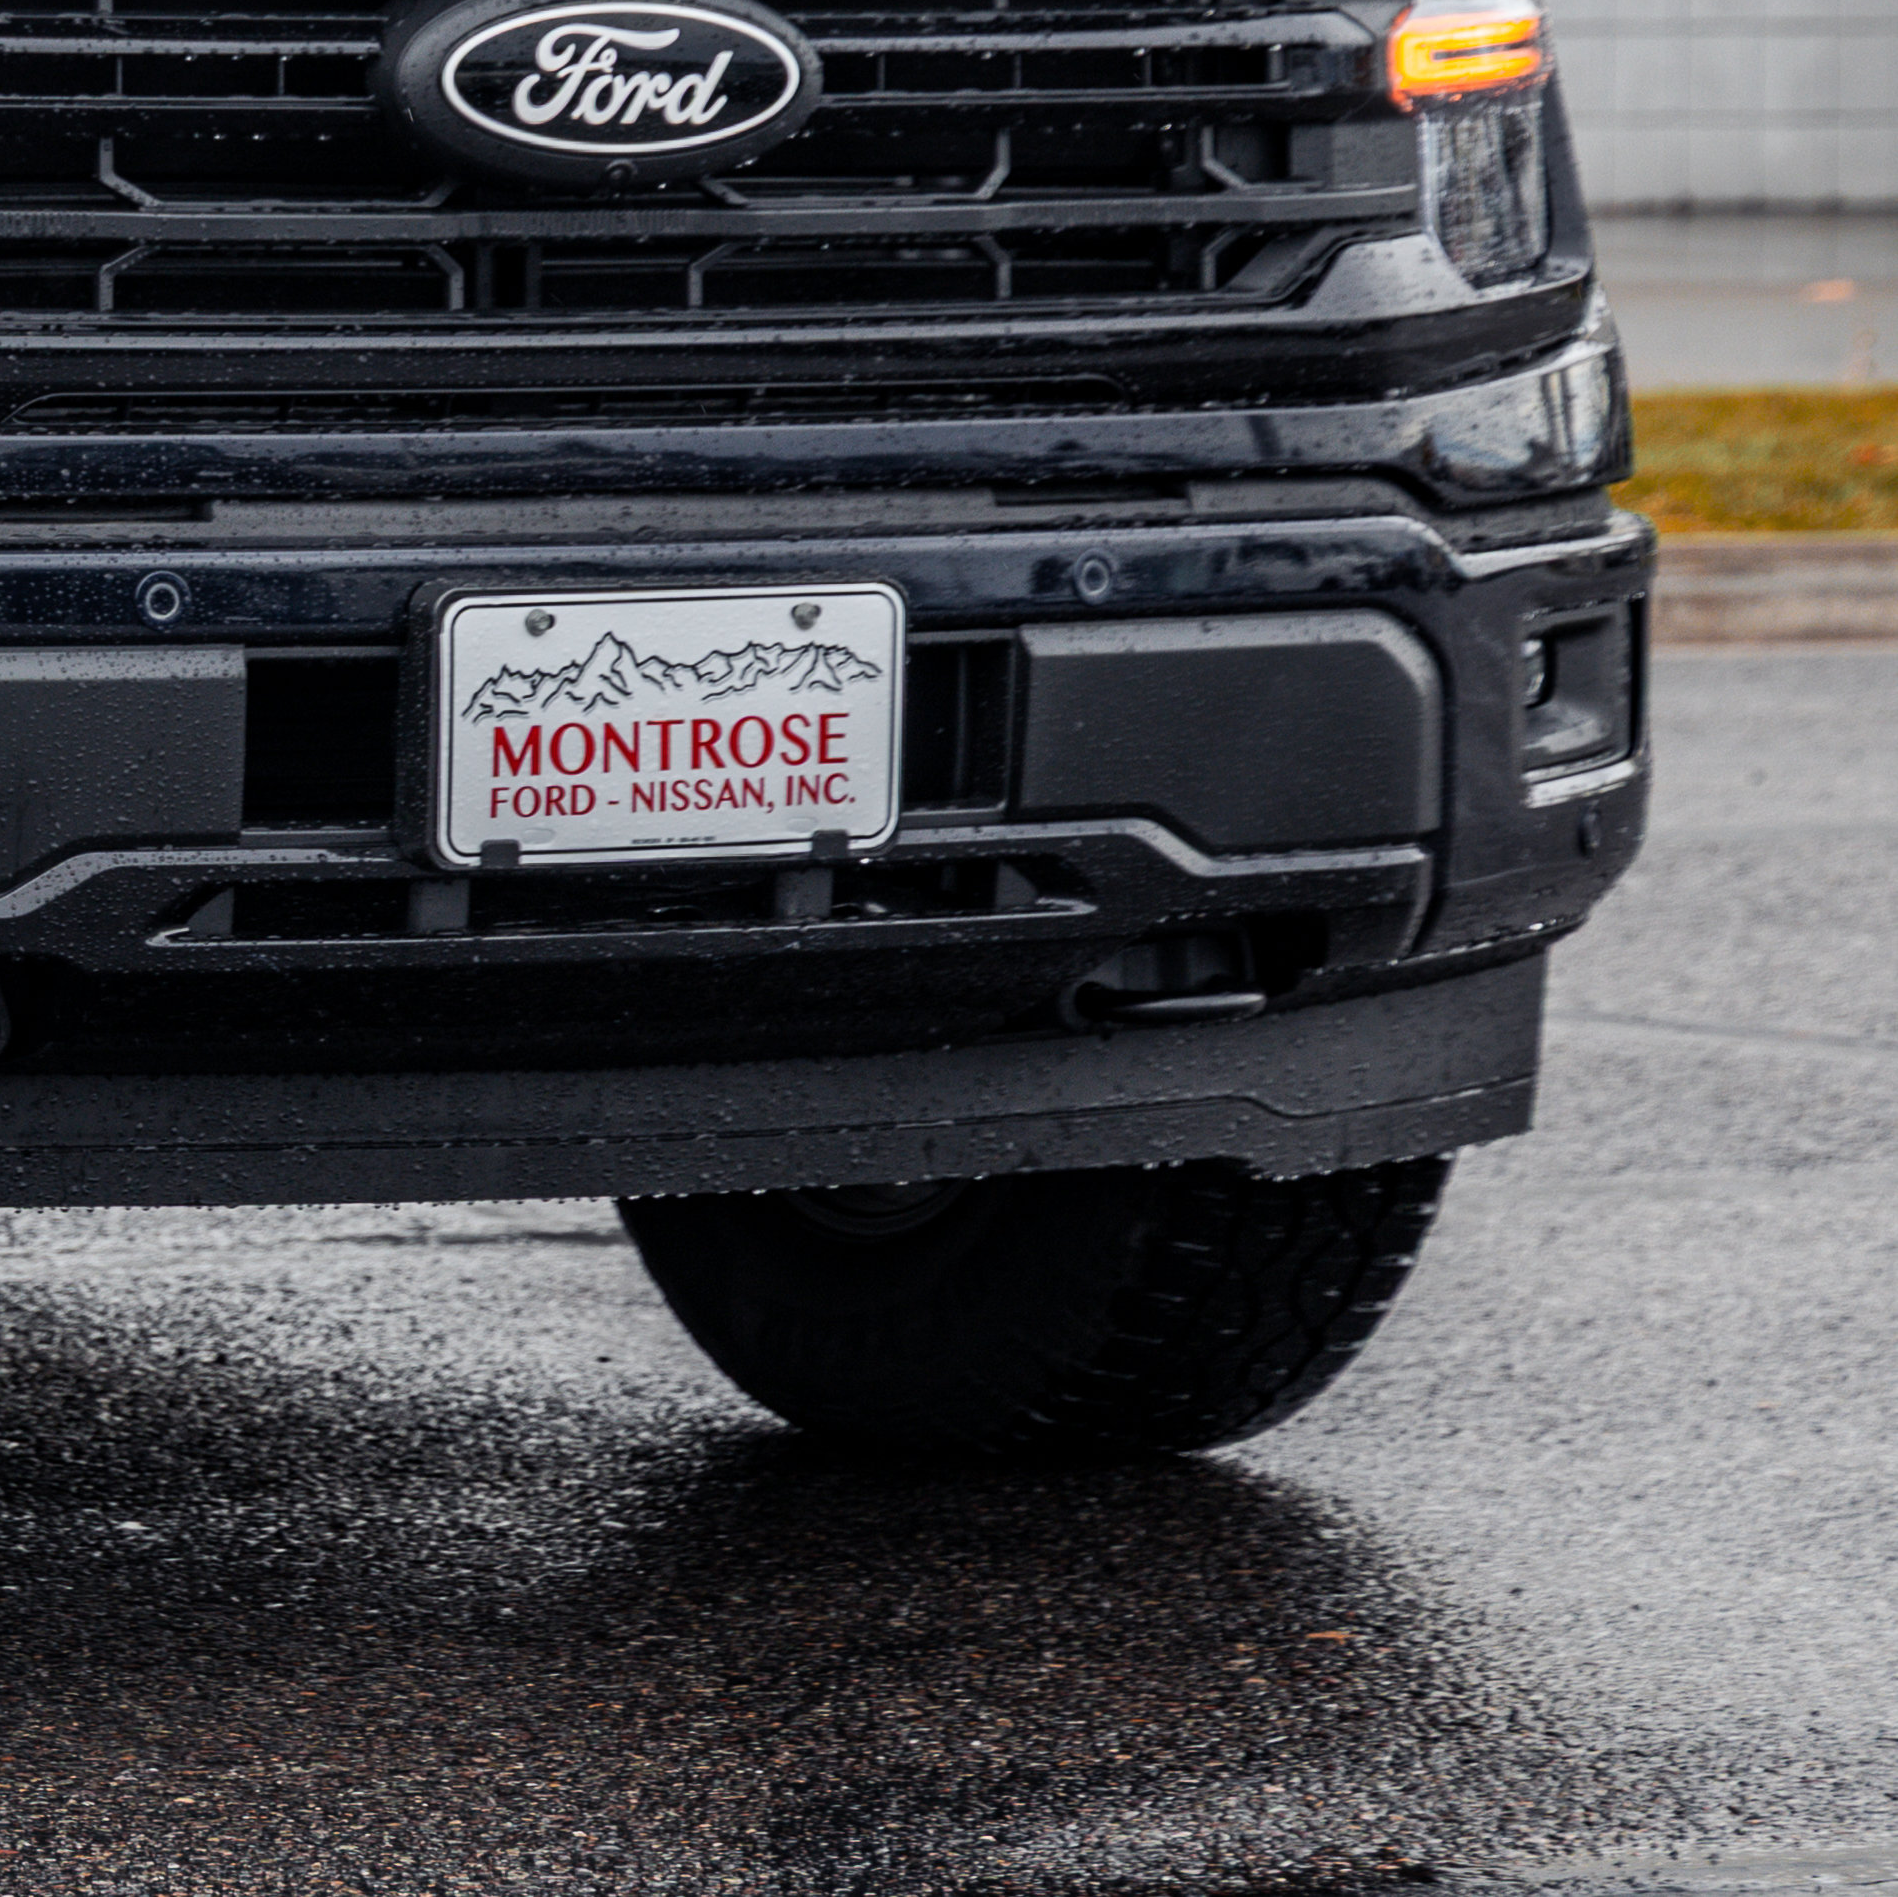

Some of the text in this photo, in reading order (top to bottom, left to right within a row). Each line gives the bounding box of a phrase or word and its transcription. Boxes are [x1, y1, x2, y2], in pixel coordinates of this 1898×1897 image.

[514, 22, 734, 126] Ford
[491, 712, 851, 778] MONTROSE
[489, 784, 597, 819] FORD
[630, 777, 776, 815] NISSAN,
[785, 771, 857, 806] INC.
